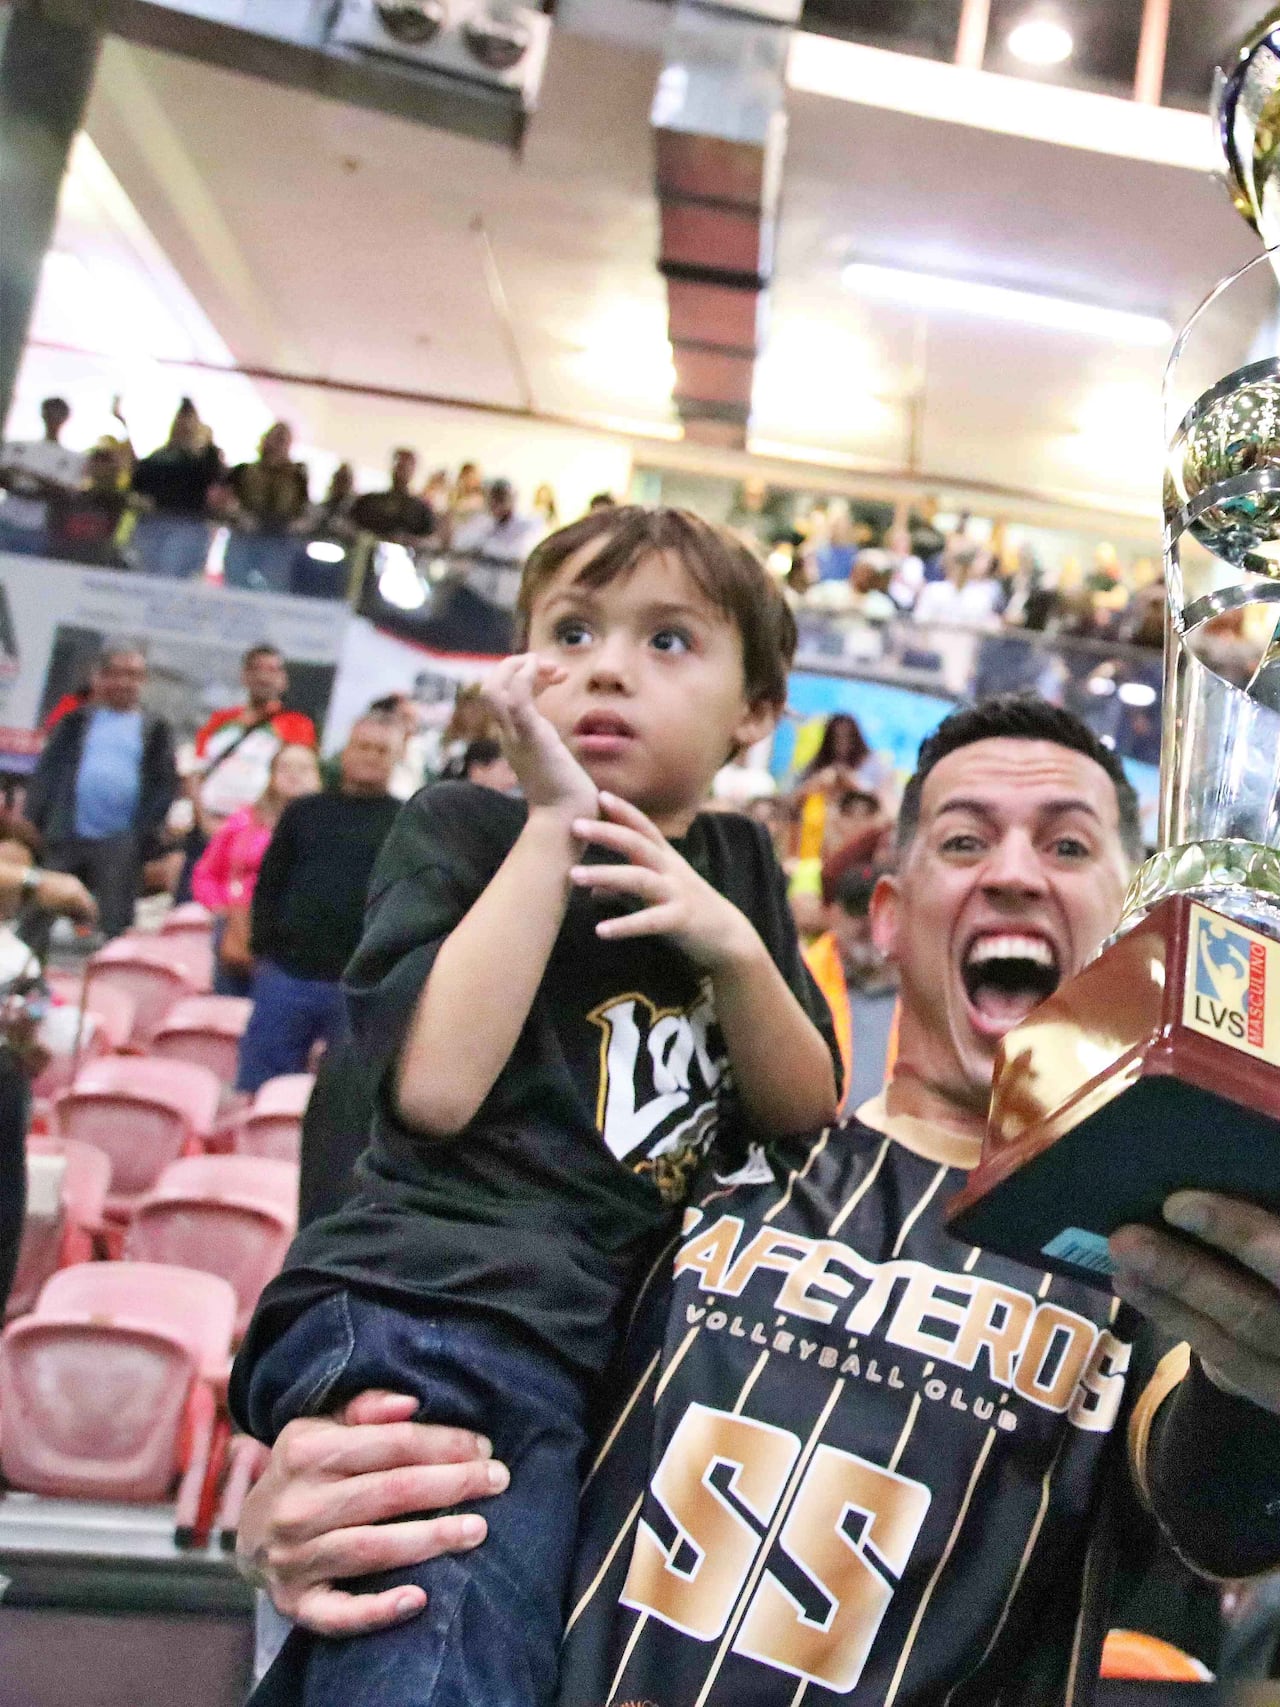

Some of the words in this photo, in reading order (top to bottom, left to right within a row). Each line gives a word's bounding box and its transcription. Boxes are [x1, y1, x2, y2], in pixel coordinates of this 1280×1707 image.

[1194, 995, 1245, 1038] LVS
[1248, 942, 1264, 1045] MASCULINO
[673, 1207, 1132, 1432] AFETEROS
[685, 1303, 905, 1389] VOLLEYBALL
[925, 1377, 1018, 1432] CLUB
